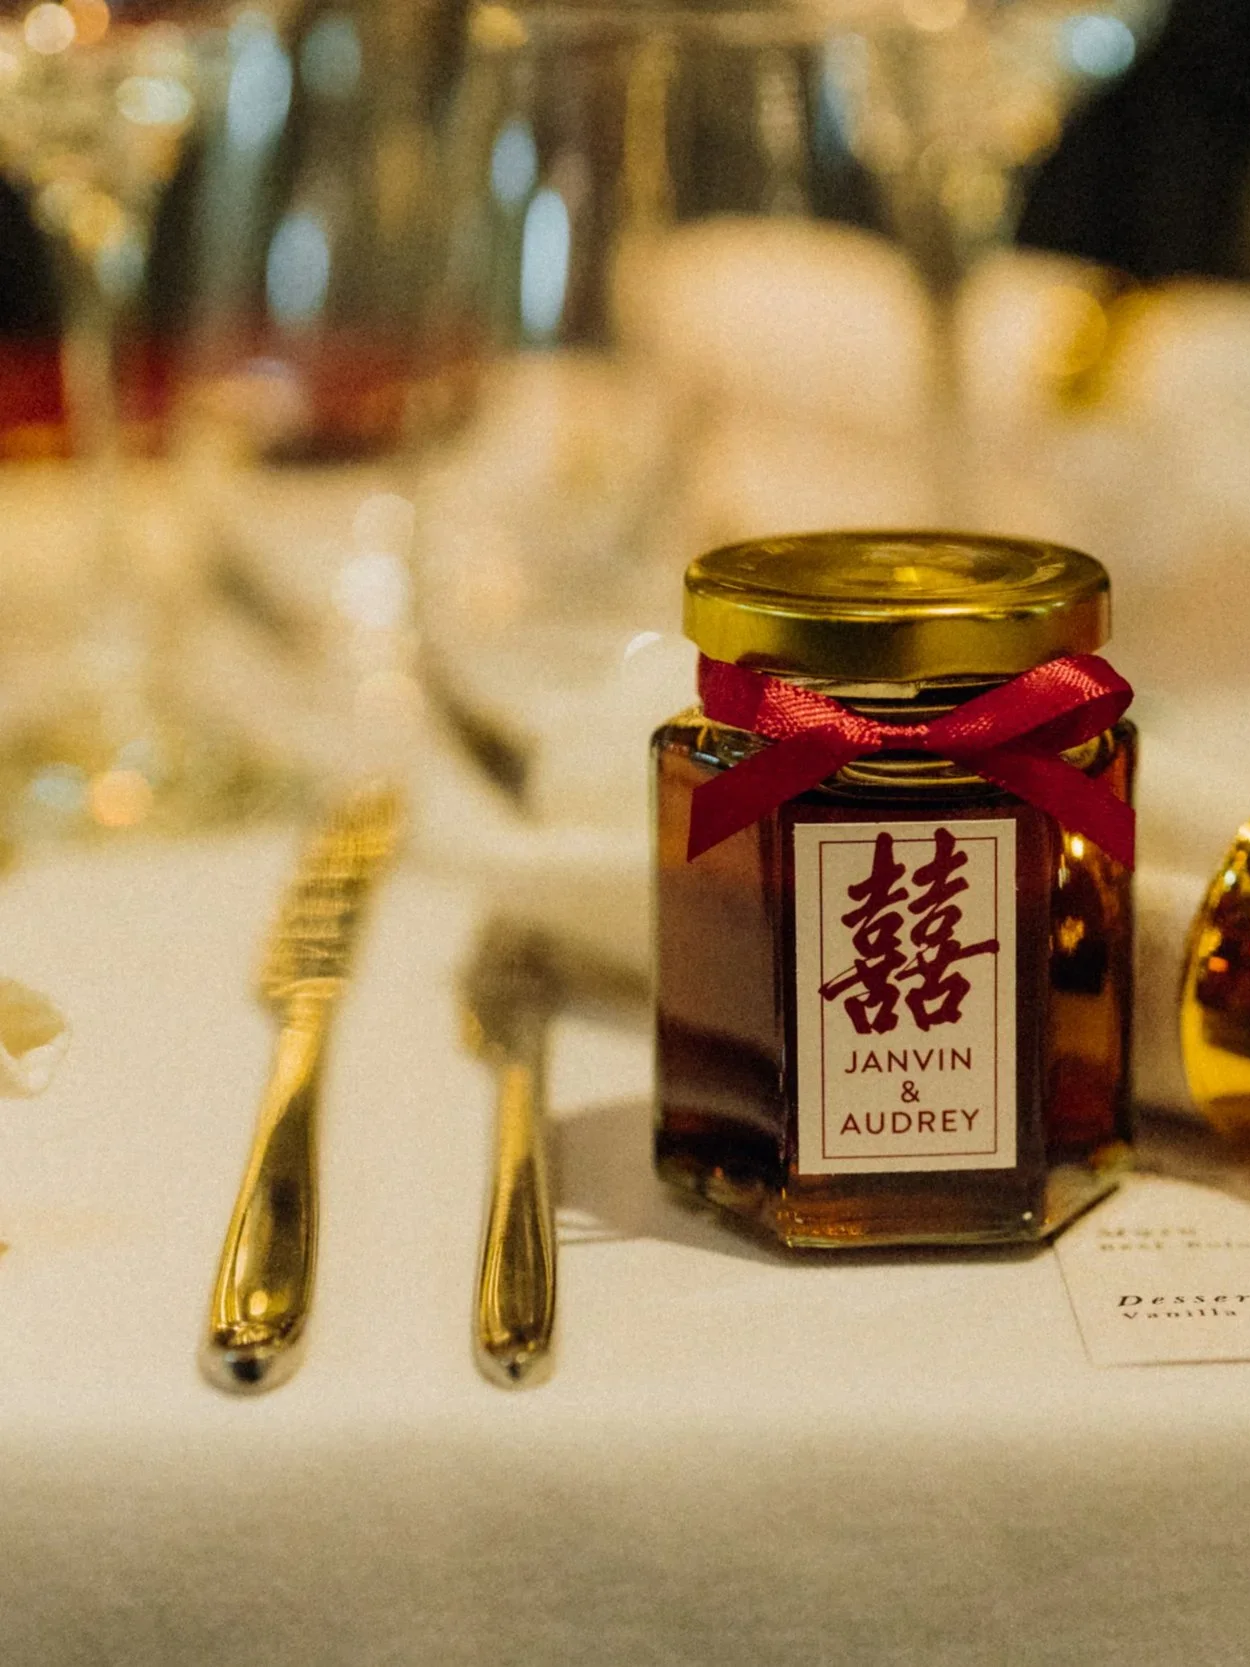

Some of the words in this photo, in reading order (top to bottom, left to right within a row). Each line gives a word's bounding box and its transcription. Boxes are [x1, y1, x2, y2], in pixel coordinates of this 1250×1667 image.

[844, 1047, 972, 1074] JANVIN
[900, 1079, 920, 1103] &
[840, 1108, 980, 1135] AUDREY
[1123, 1308, 1238, 1320] Vanilla
